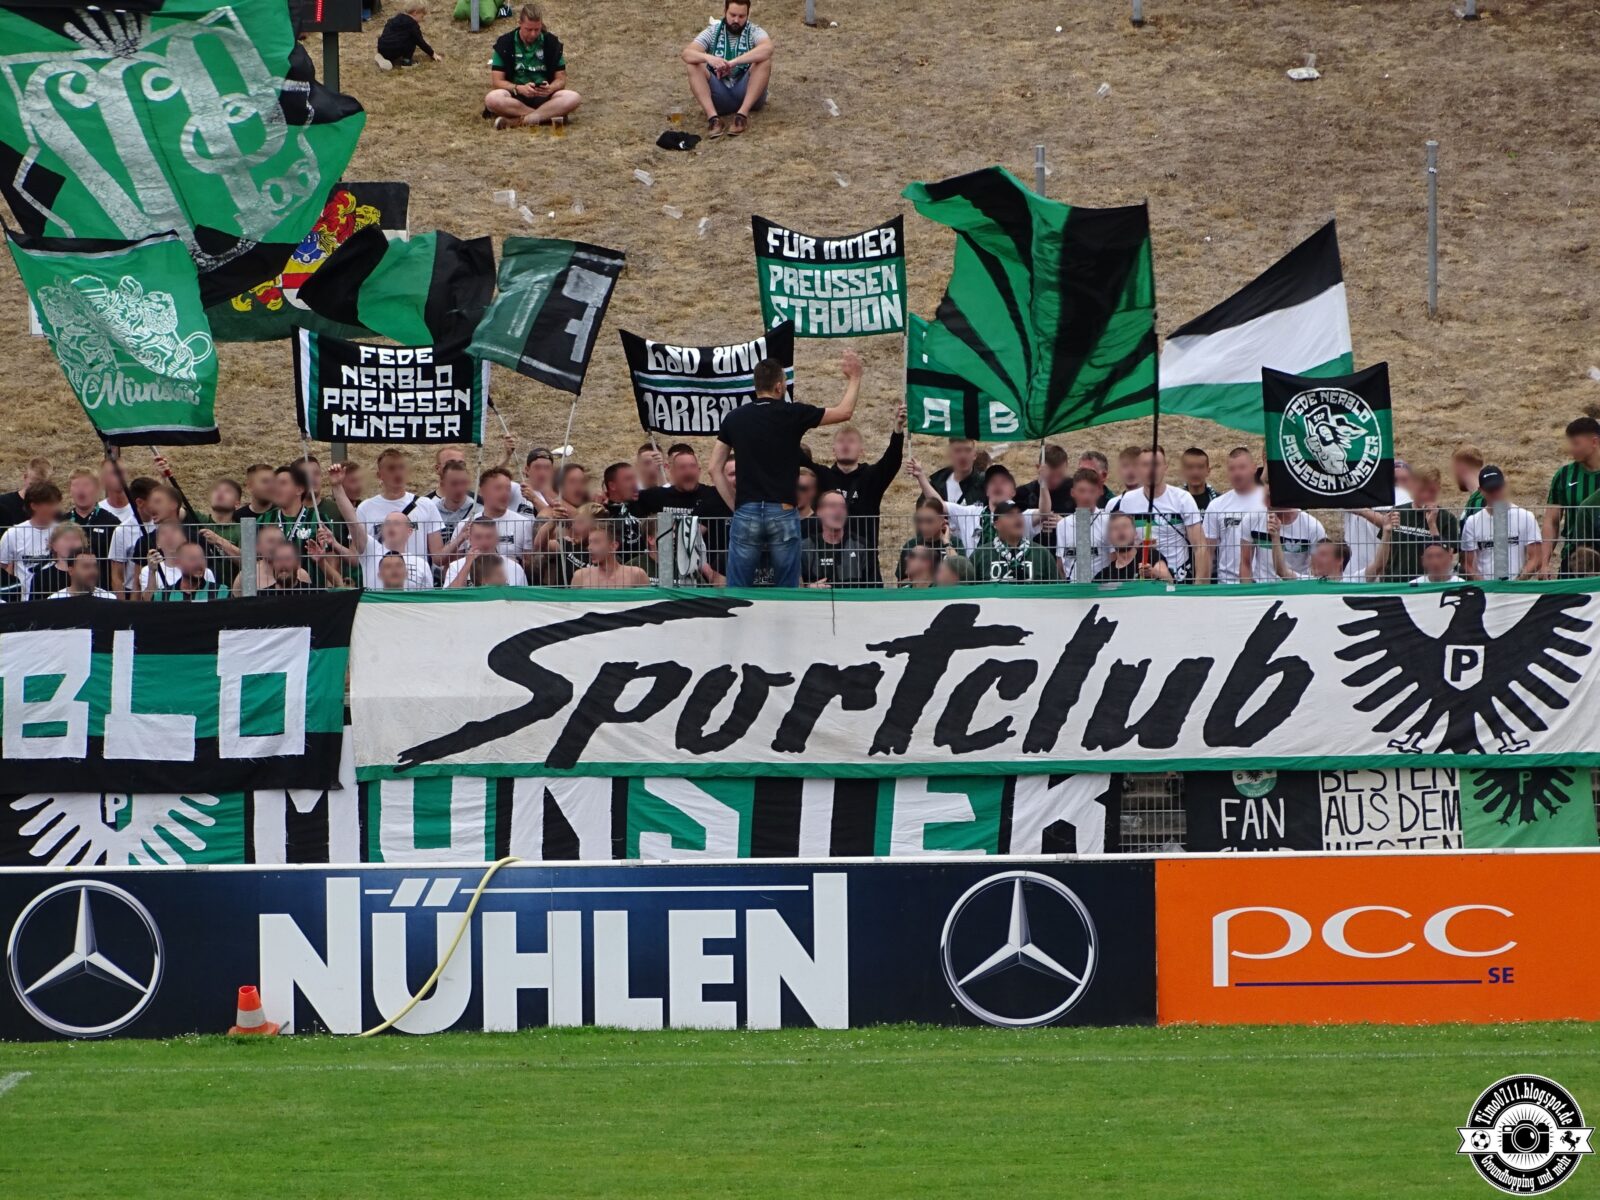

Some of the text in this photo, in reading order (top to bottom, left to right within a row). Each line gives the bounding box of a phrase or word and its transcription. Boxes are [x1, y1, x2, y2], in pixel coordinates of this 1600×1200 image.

[767, 227, 897, 260] FÜR IMMER
[768, 264, 898, 298] PREUSSEN
[770, 294, 904, 335] STADION
[359, 345, 434, 365] FEDE
[341, 365, 453, 388] NERBLO
[323, 387, 471, 413] PREUSSEN
[923, 397, 1020, 434] A B
[1286, 390, 1372, 424] FEDE NERBLO
[332, 413, 461, 438] MÜNSTER
[1283, 434, 1379, 490] PREUSSEN MÜNSTER
[990, 561, 1033, 580] 021
[1449, 646, 1479, 683] P
[0, 627, 312, 762] BLO
[394, 597, 1315, 772] Sportclub
[1519, 771, 1532, 795] P
[105, 793, 128, 823] P
[1221, 797, 1285, 840] FAN
[1325, 790, 1463, 836] AUS DEM
[259, 873, 849, 1034] NÜHLEN
[1488, 967, 1514, 984] SE
